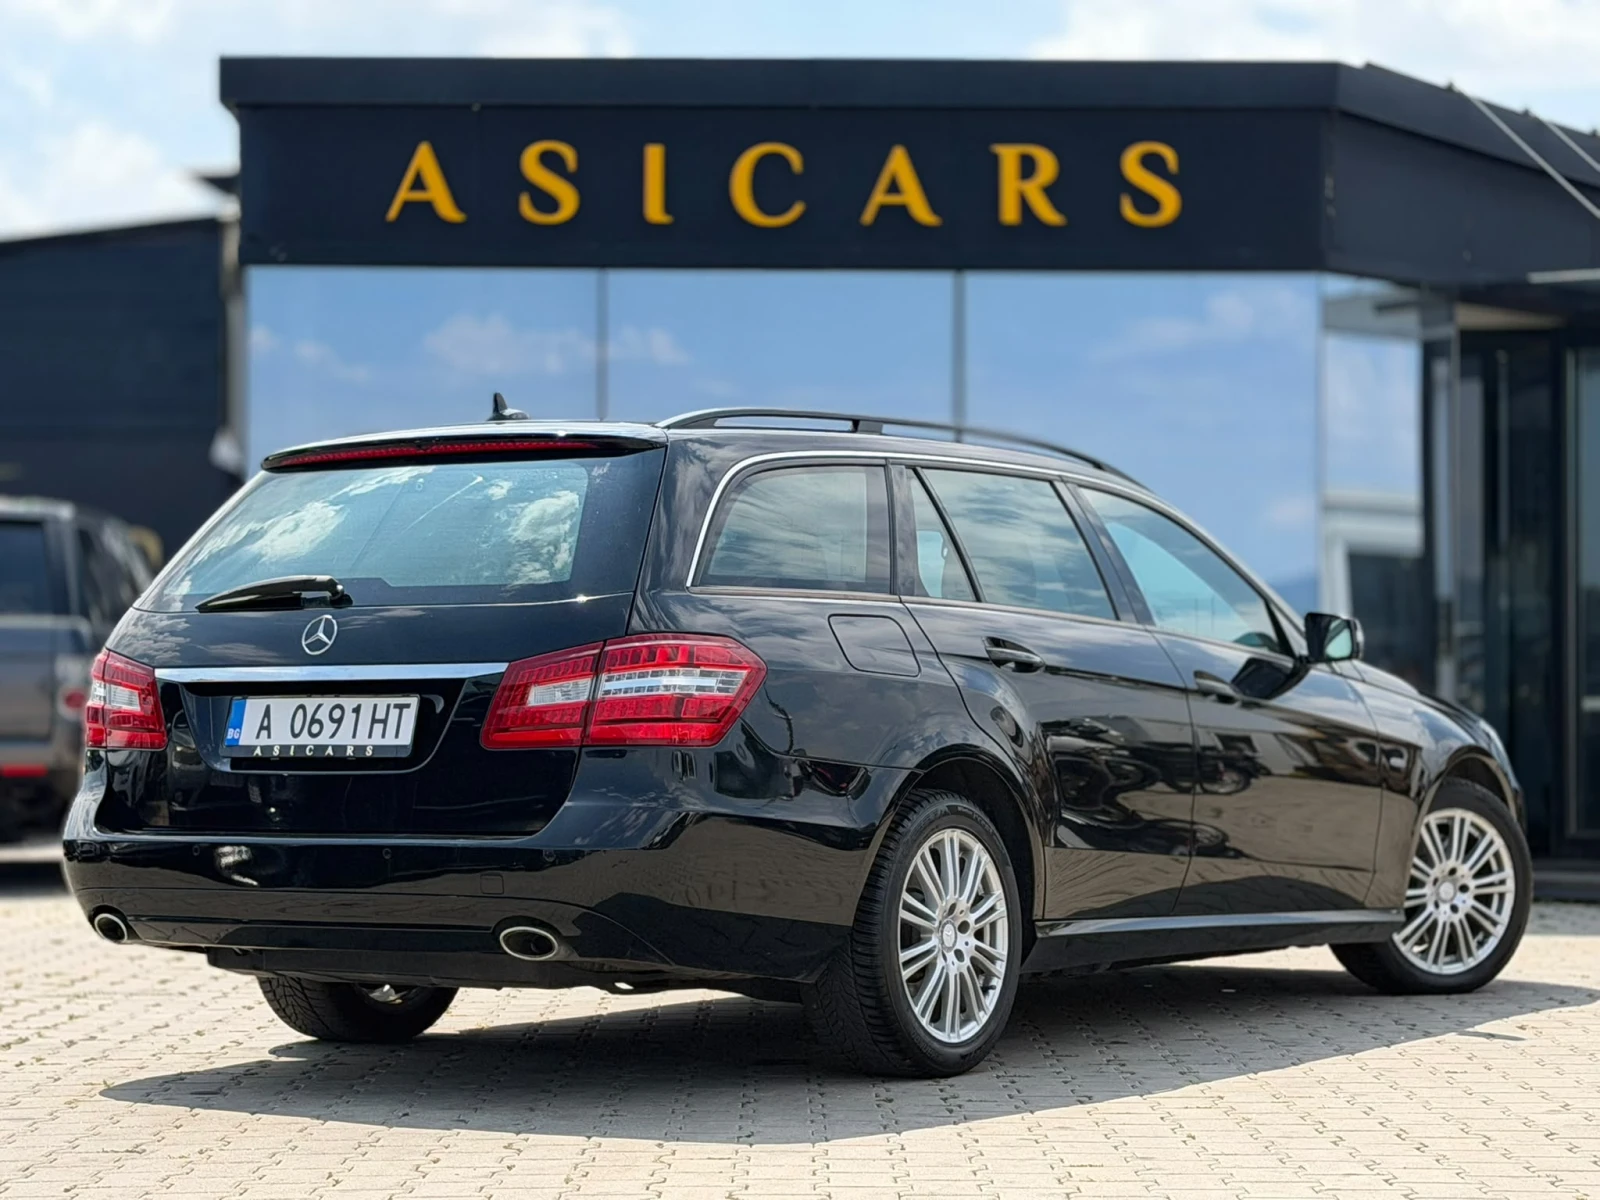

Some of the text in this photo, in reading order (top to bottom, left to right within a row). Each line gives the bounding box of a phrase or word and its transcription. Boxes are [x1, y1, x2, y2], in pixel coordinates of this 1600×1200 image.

[385, 139, 1183, 228] ASICARS
[255, 703, 272, 740] A
[227, 728, 241, 740] BG
[253, 745, 374, 757] ASICARS
